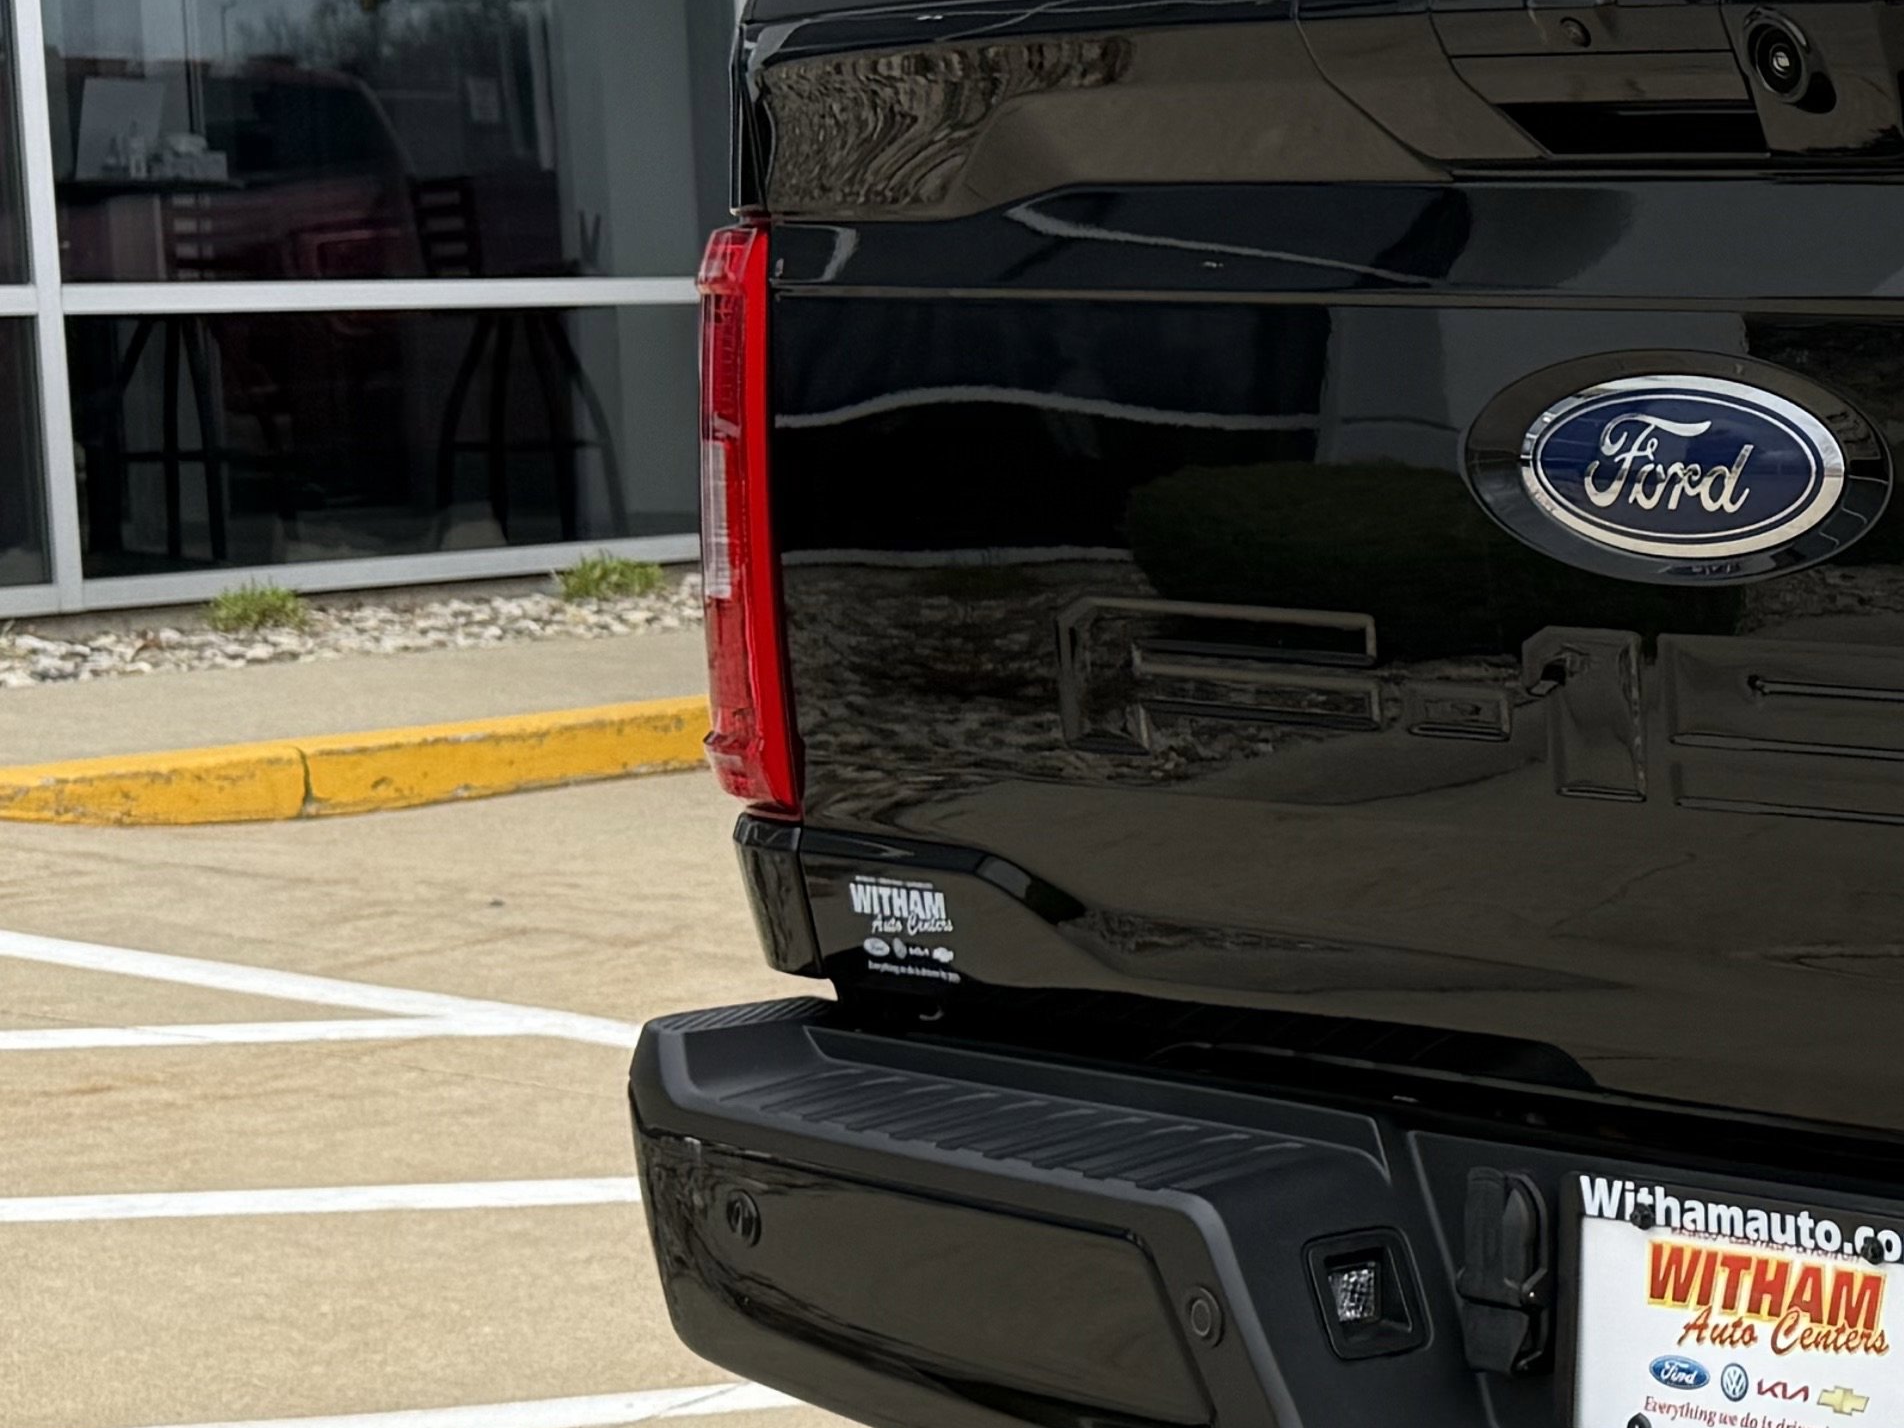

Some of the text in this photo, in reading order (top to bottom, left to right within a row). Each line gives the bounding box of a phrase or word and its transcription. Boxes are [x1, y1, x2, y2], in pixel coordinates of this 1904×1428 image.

[1584, 412, 1754, 514] Ford
[849, 882, 946, 920] WITHAM
[872, 911, 954, 936] Auto Centers
[1648, 1240, 1886, 1333] WITHAM
[1677, 1305, 1889, 1355] Auto Centers
[1644, 1395, 1717, 1428] Everything
[1719, 1413, 1738, 1427] we
